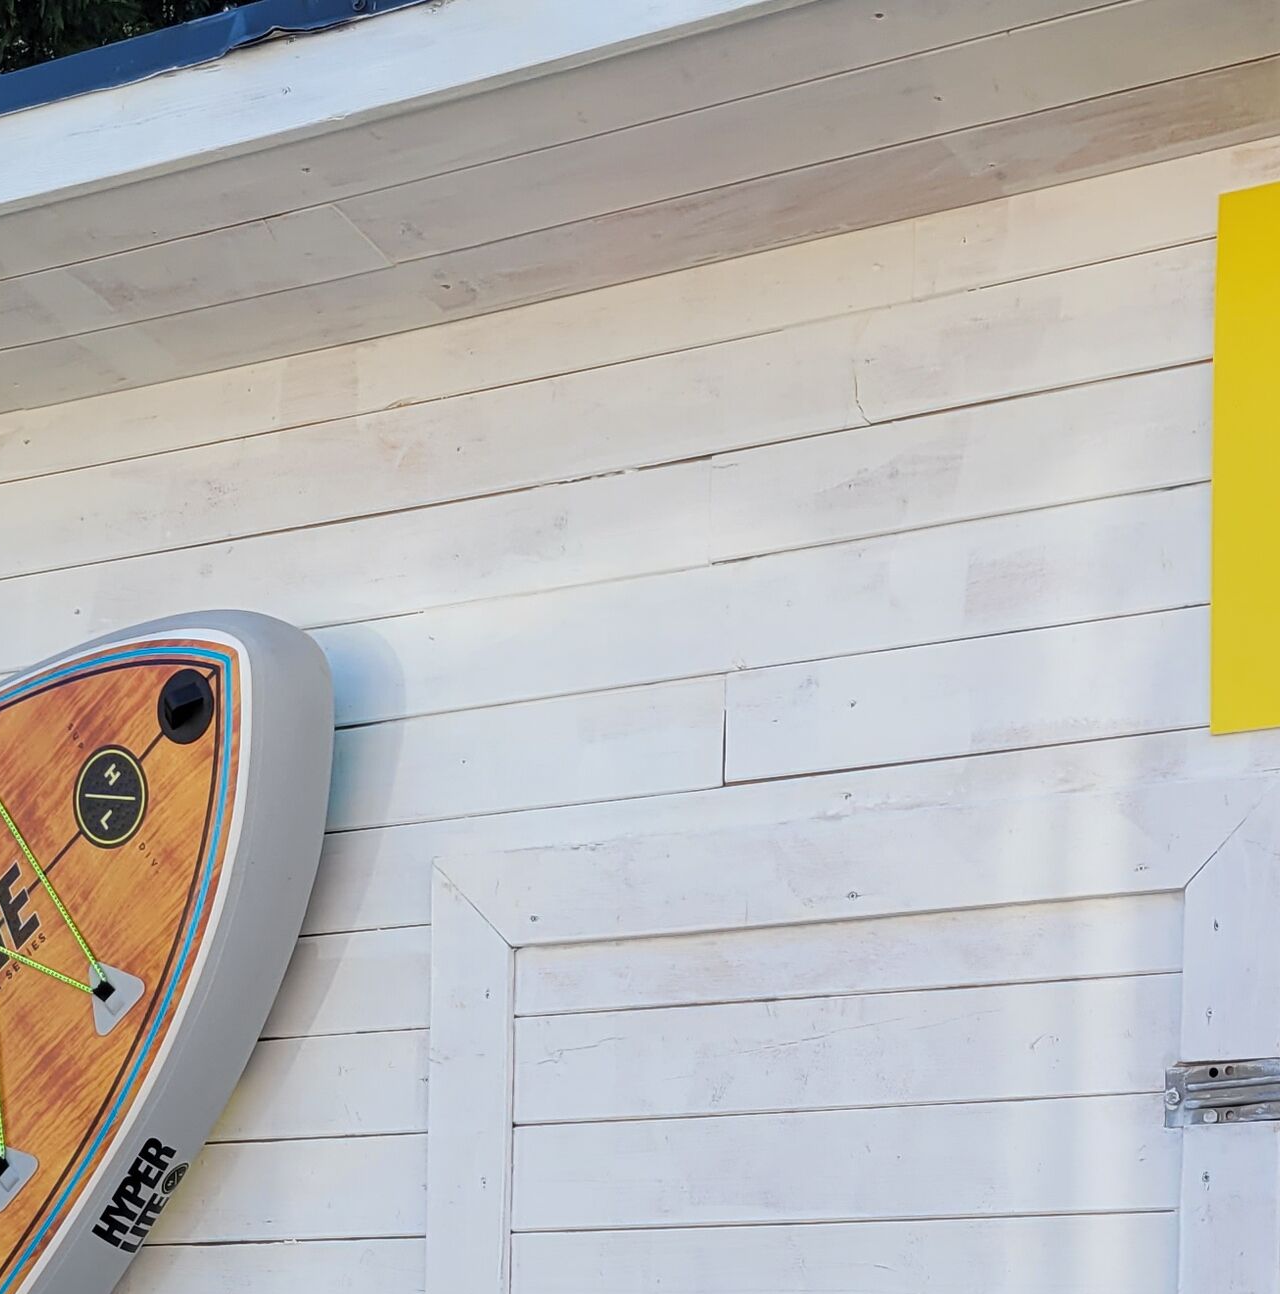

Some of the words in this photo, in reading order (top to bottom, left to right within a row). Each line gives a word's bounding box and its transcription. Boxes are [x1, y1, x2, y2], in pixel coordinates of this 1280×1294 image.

[5, 932, 47, 980] SEIES
[91, 1137, 177, 1248] HYPER
[119, 1192, 170, 1254] LITE
